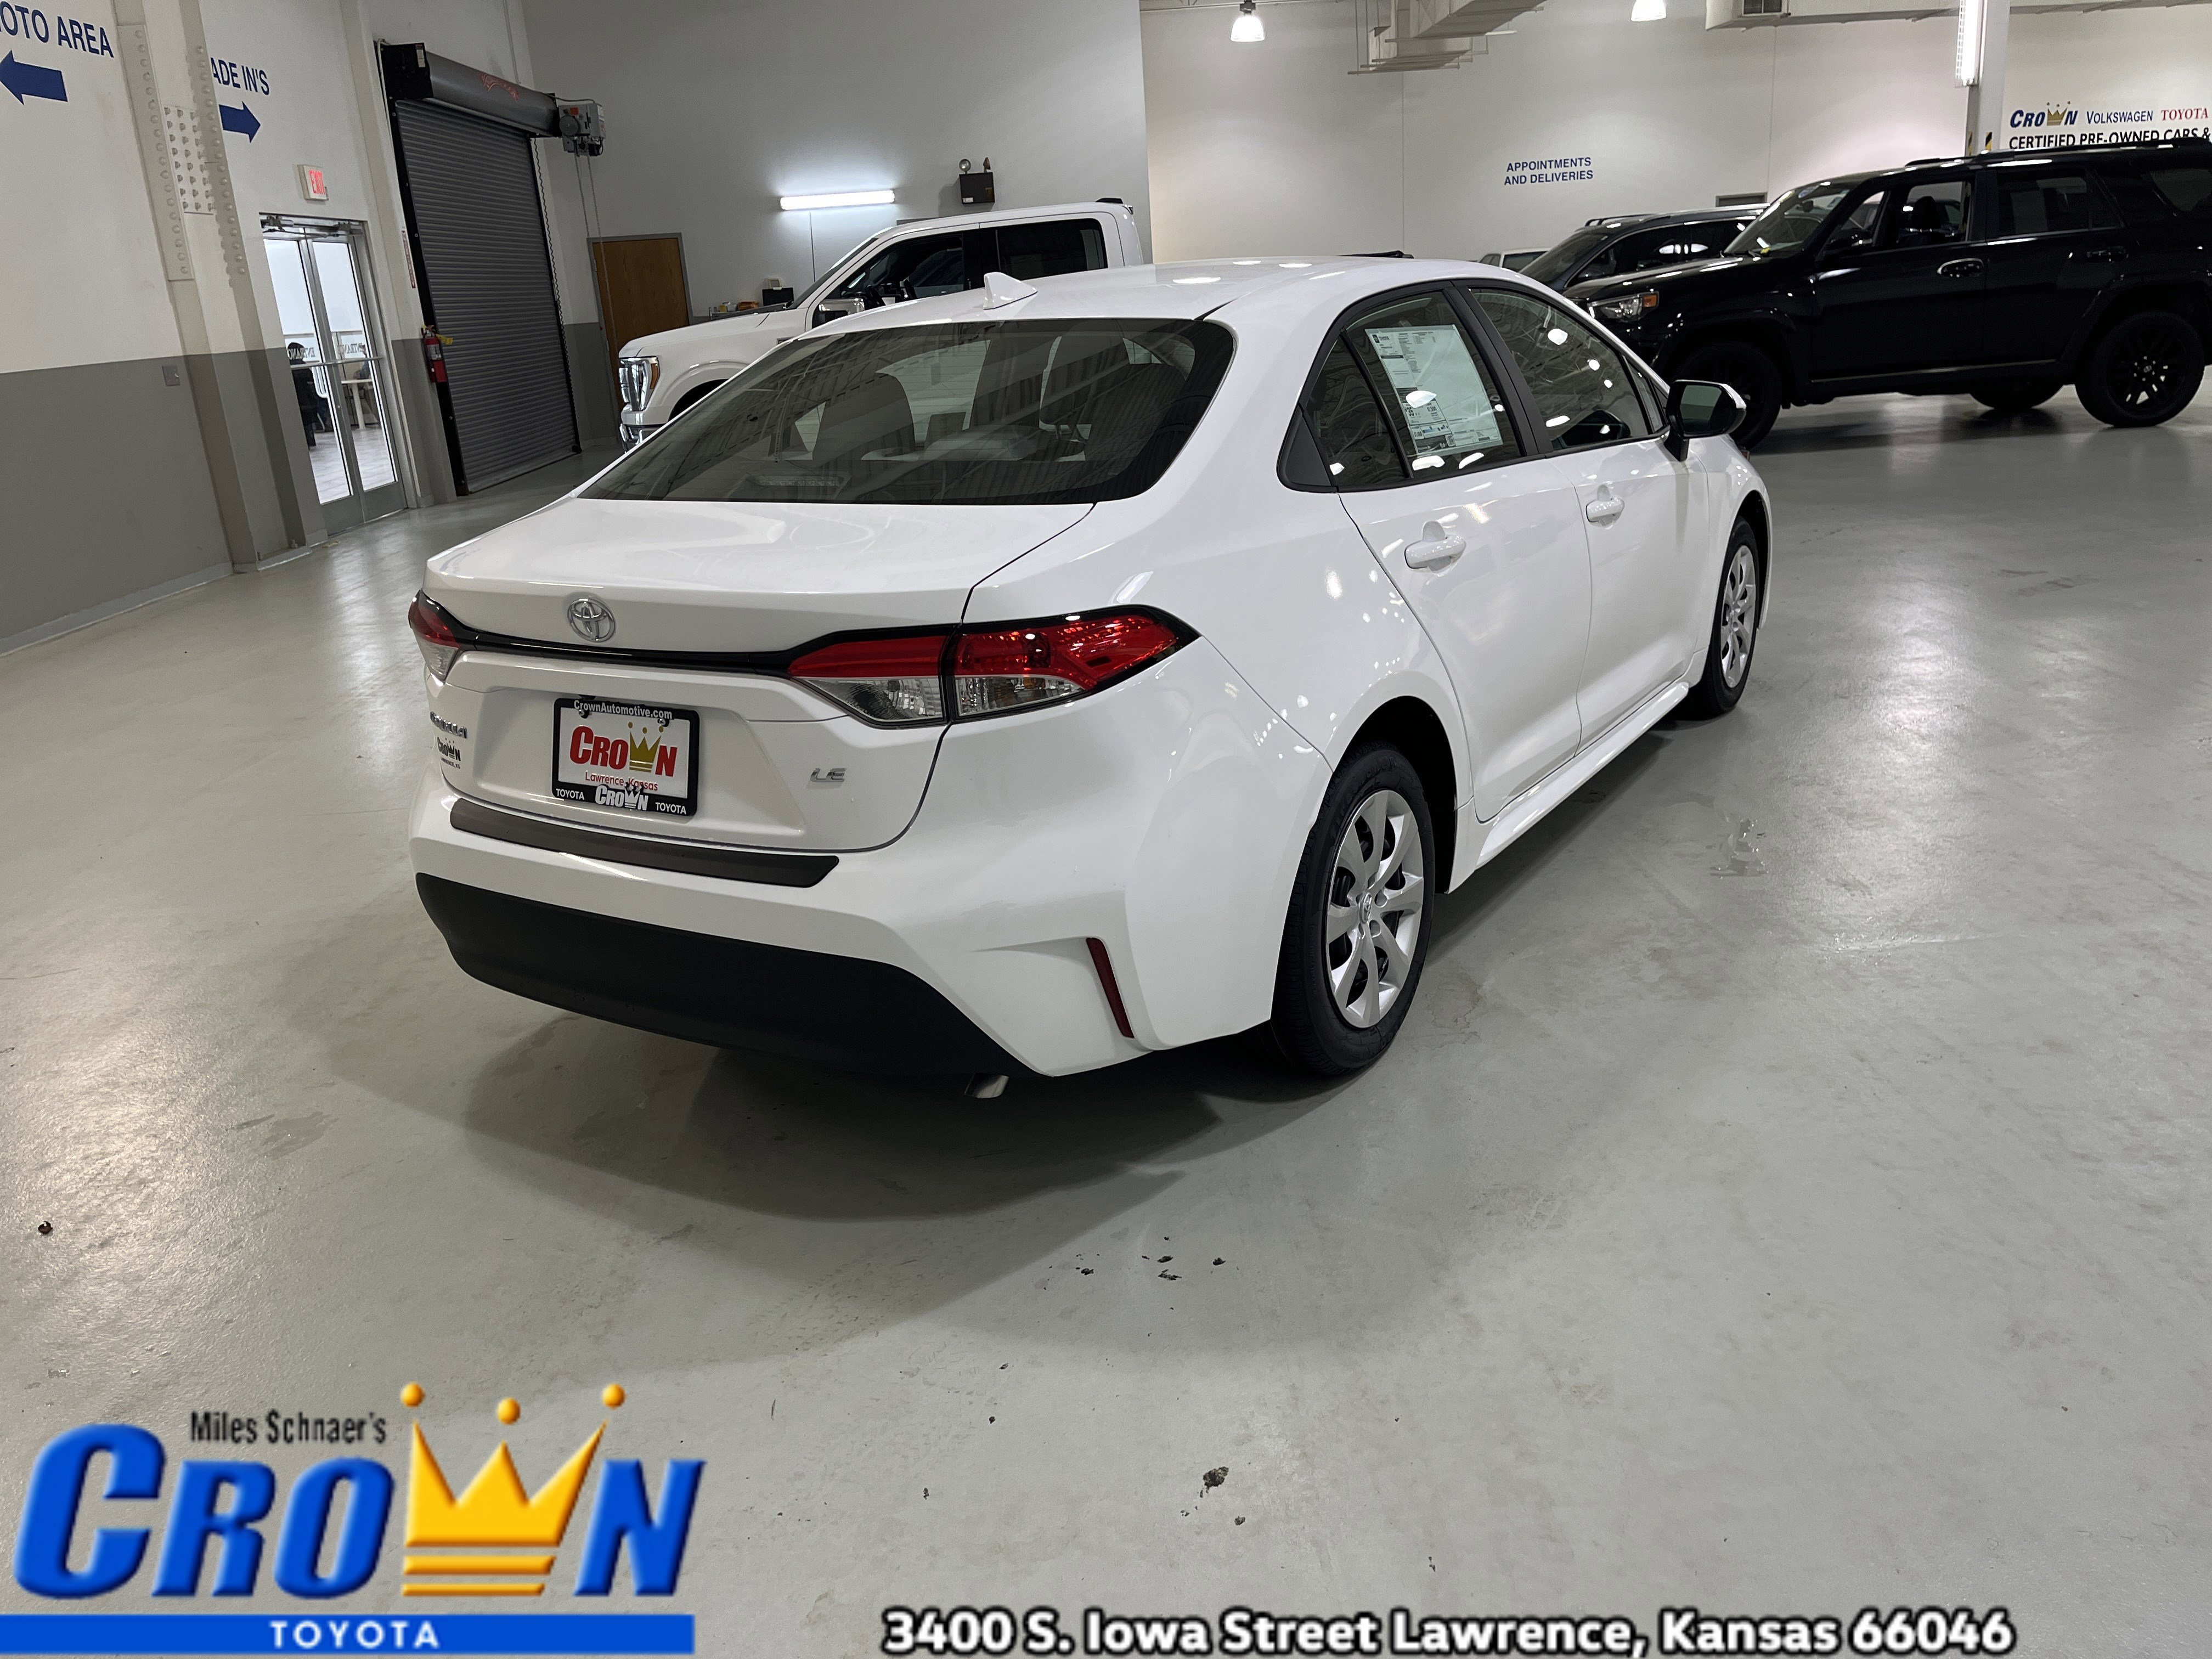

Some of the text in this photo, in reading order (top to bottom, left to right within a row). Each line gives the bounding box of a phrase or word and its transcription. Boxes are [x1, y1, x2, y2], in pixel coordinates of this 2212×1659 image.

[0, 1, 114, 58] OTO AREA
[210, 57, 269, 95] ADE IN'S
[2010, 107, 2209, 128] CROWN VOLKSWAGEN TOYOTA
[2009, 134, 2075, 149] CERTIFIED
[2080, 130, 2159, 145] PRE-OWNED
[2164, 128, 2198, 140] CARS
[1506, 157, 1592, 172] APPOINTMENTS
[1504, 170, 1593, 185] AND DELIVERIES
[574, 699, 673, 719] CrownAutomotive.com
[569, 724, 678, 777] CROWN
[628, 777, 658, 791] Kansas
[810, 768, 847, 782] LE
[556, 785, 687, 815] TOYOTA CROWN TOYOTA
